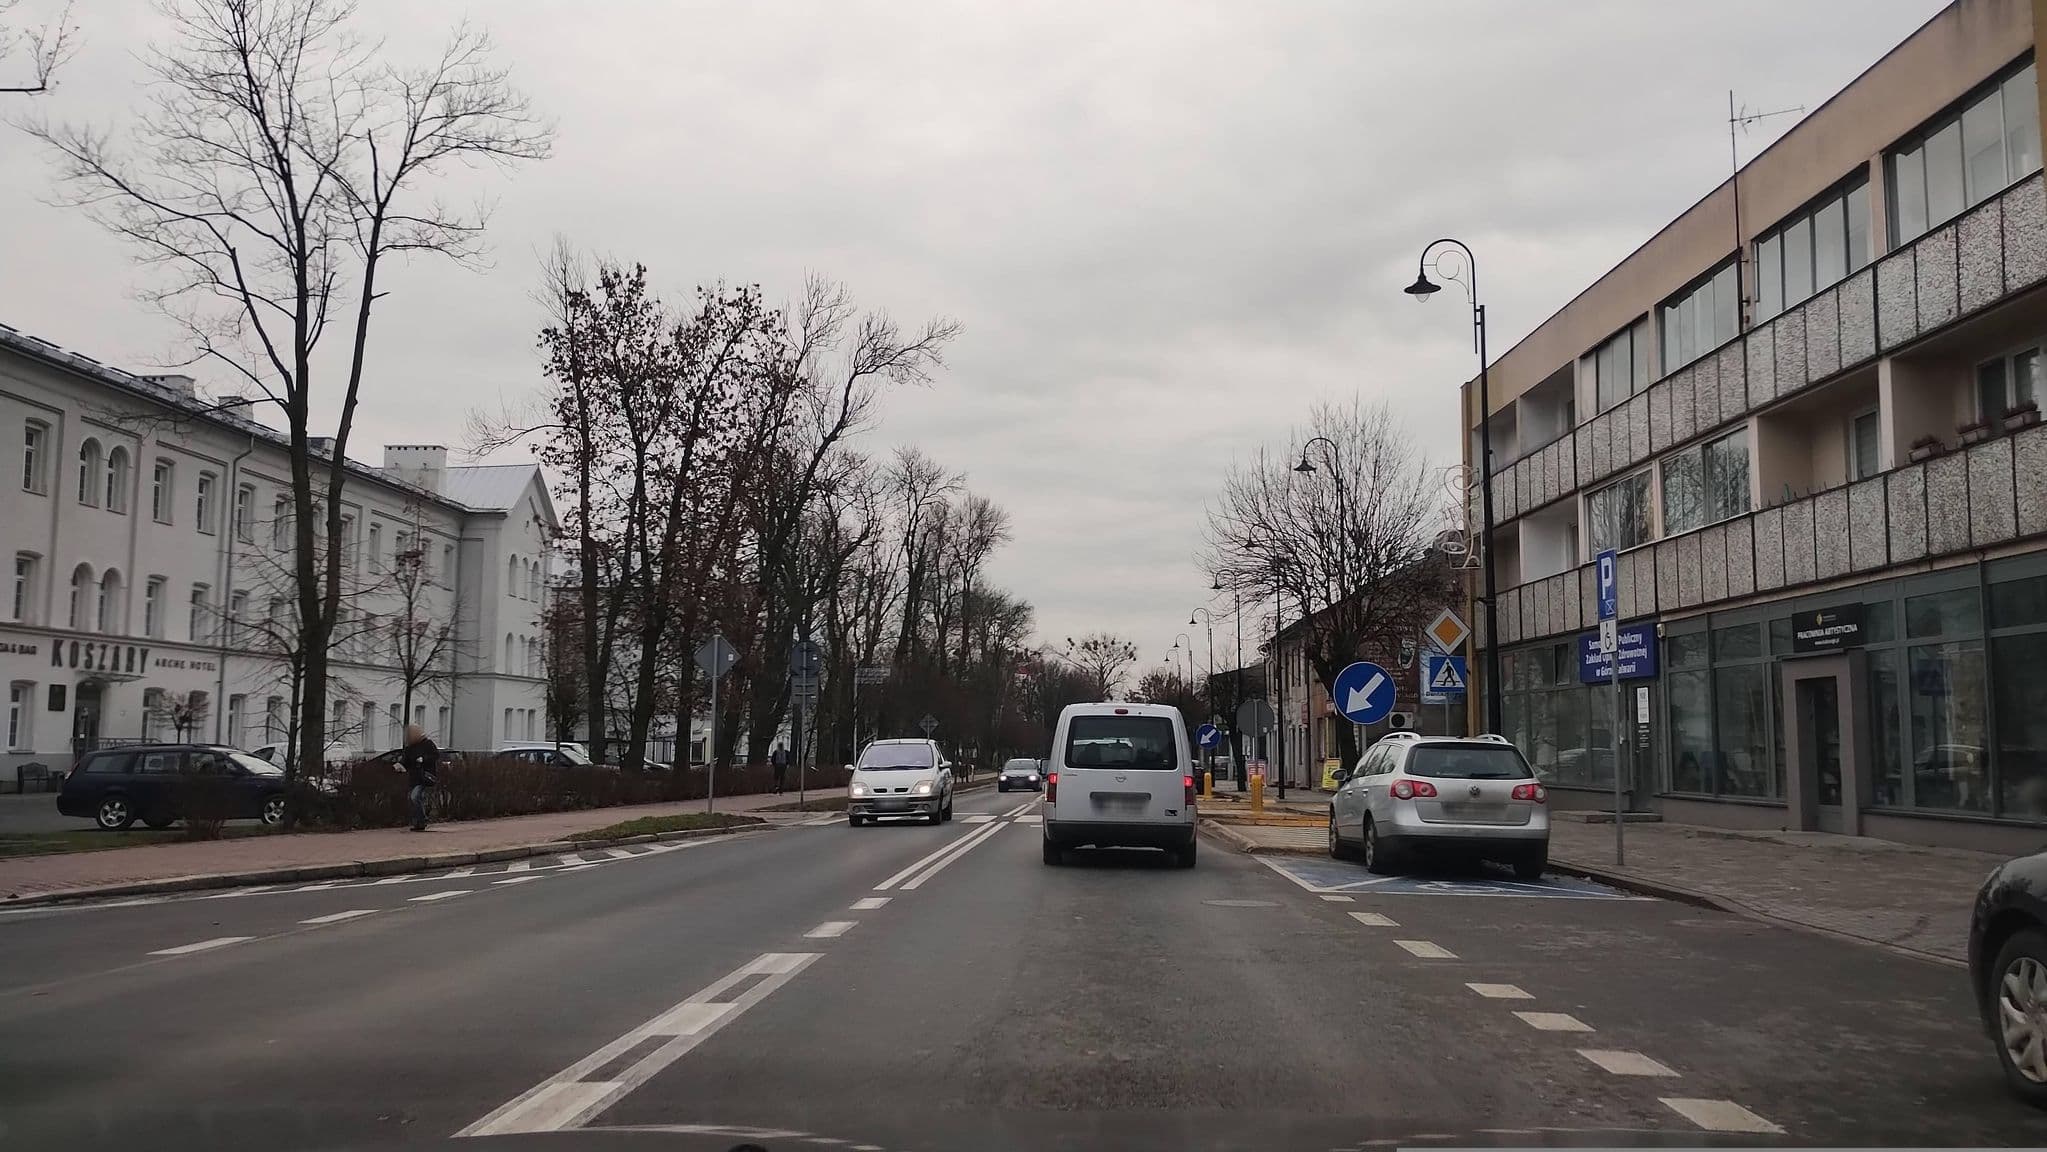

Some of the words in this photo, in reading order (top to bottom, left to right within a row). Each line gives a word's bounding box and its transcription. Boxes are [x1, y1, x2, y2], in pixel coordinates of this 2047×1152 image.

[1601, 557, 1612, 600] P
[1825, 624, 1858, 635] ARTYSTYCZNA
[1618, 632, 1642, 645] Publiczny
[18, 644, 37, 656] BAR
[52, 639, 149, 673] KOSZARY
[1618, 645, 1647, 660] Zdrowotnej
[155, 658, 185, 669] ARCHE
[190, 661, 217, 671] HOTEL
[1617, 662, 1636, 674] alwarii
